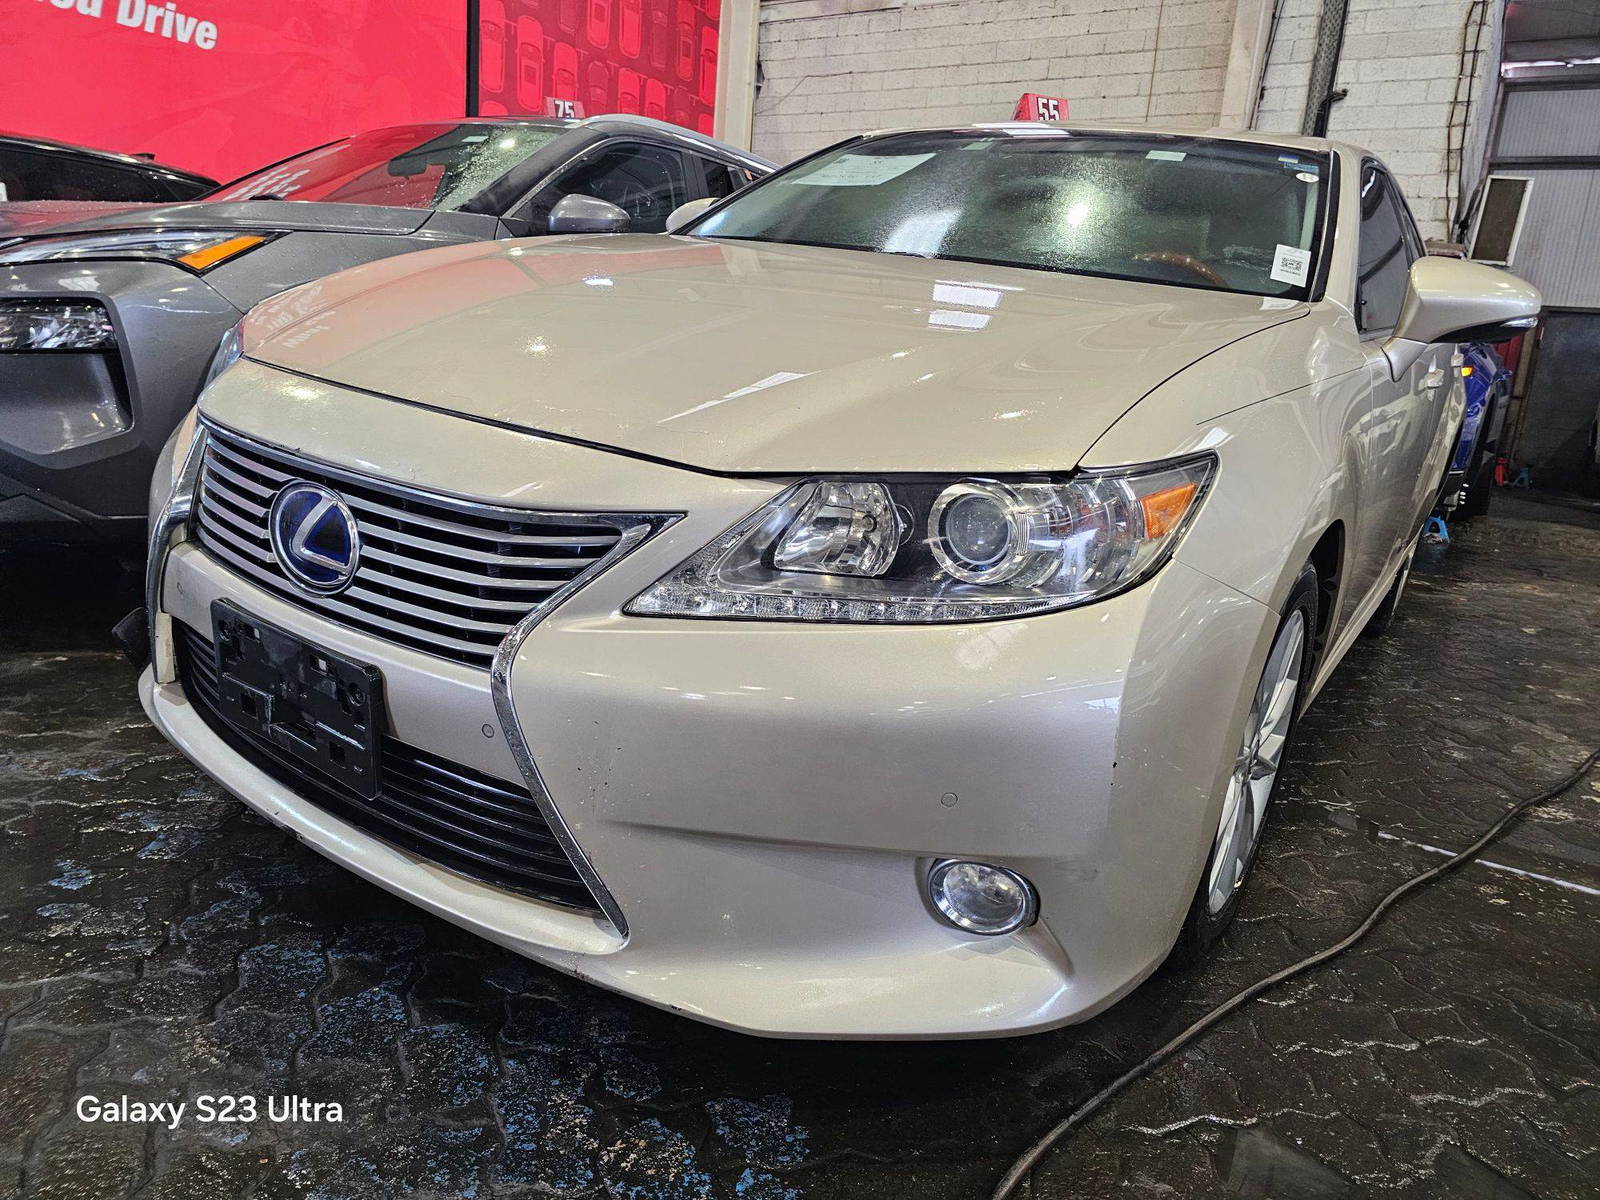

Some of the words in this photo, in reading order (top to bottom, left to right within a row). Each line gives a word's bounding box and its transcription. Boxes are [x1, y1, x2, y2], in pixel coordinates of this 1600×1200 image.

[116, 0, 218, 50] Drive
[553, 99, 575, 118] 75
[1037, 97, 1060, 120] 55
